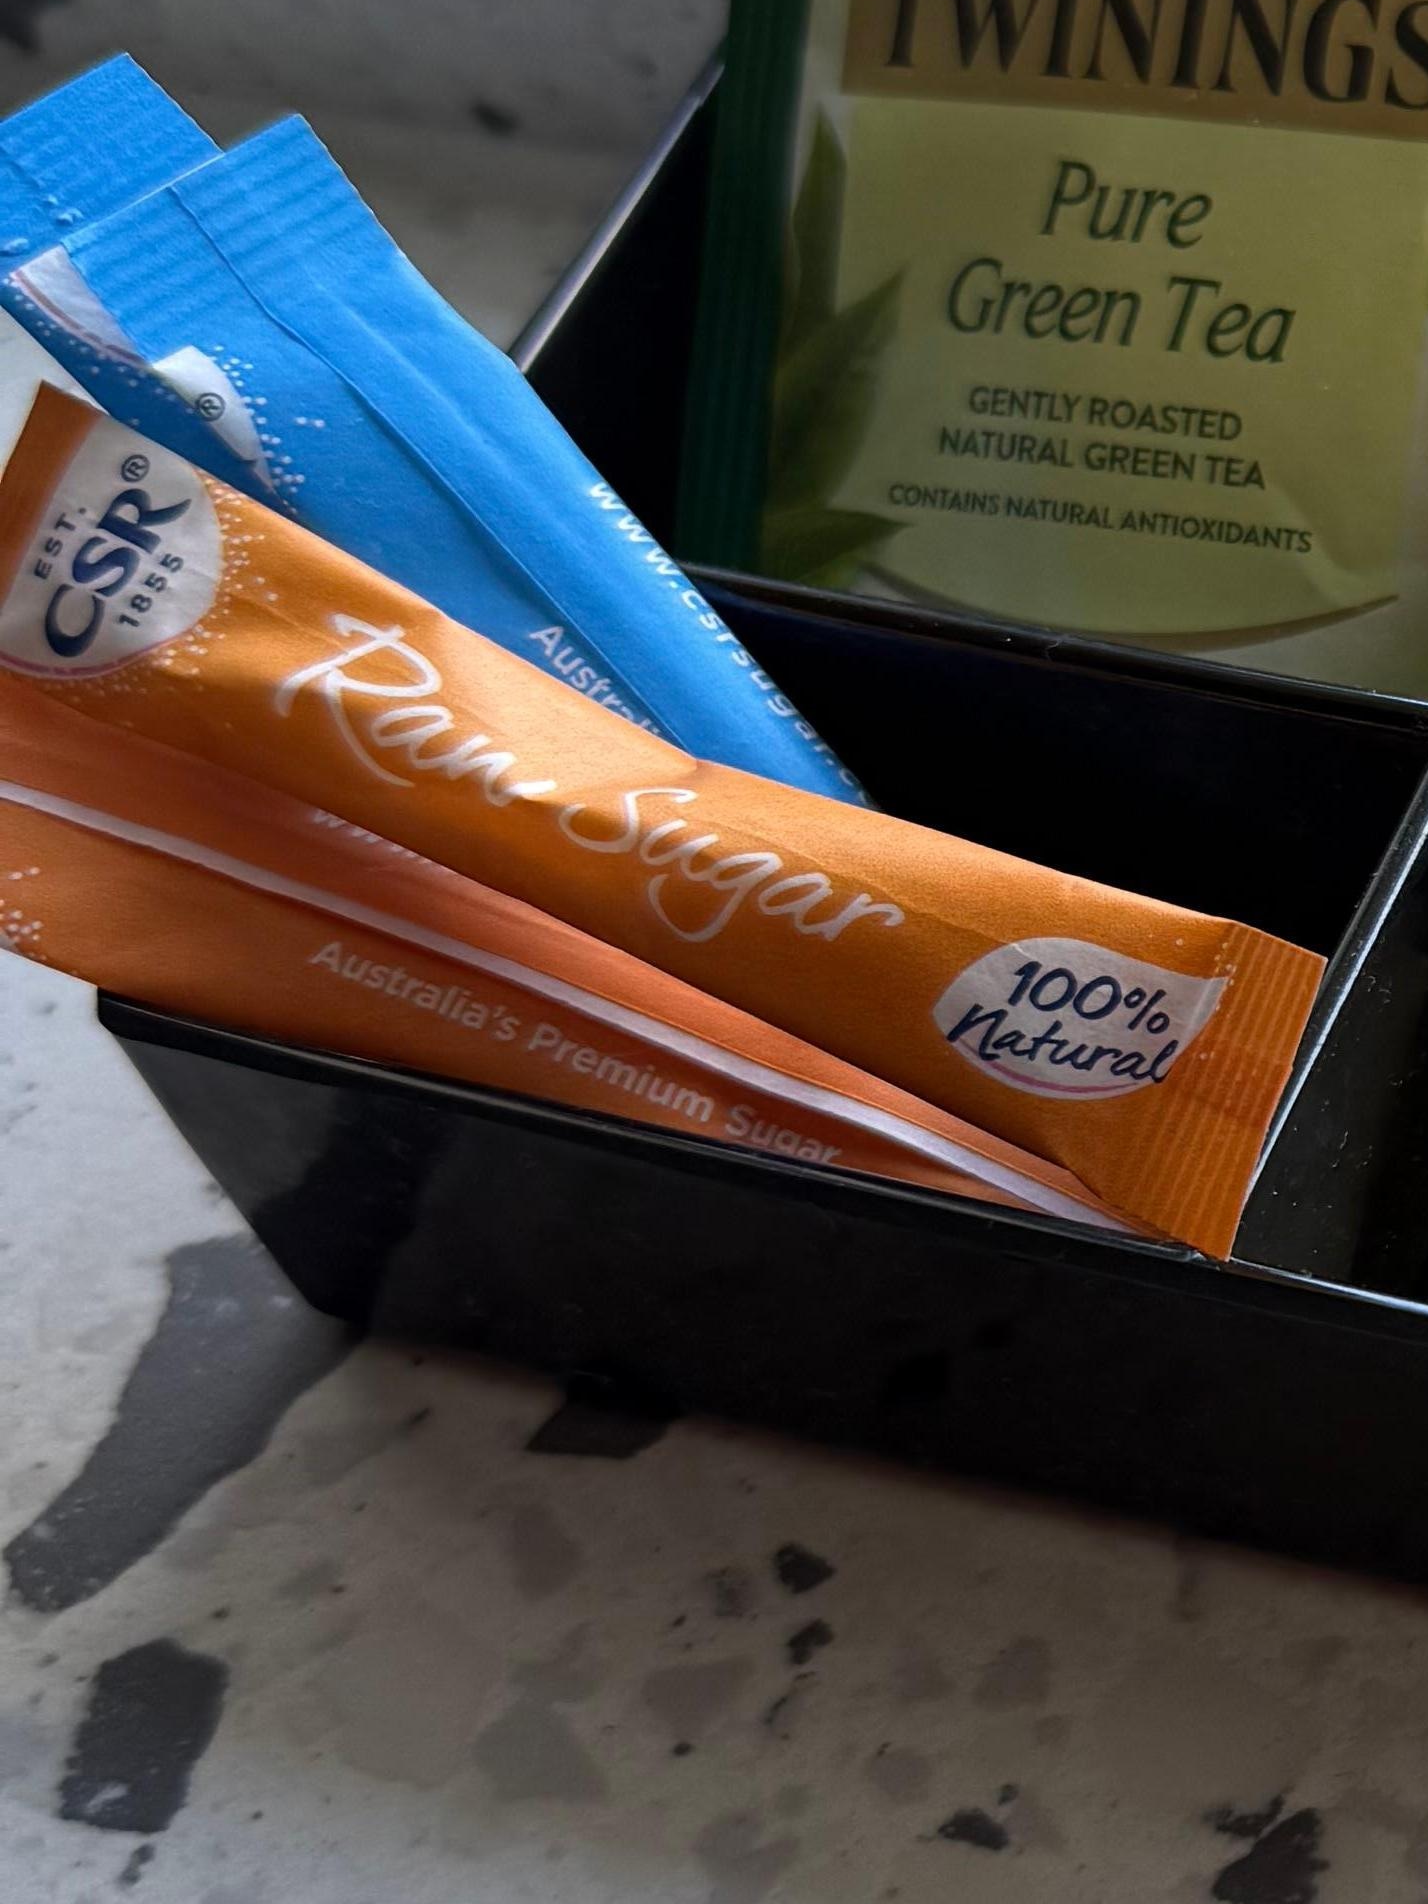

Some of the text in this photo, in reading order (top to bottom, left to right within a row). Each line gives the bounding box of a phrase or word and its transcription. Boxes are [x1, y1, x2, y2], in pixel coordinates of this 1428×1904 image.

[1039, 159, 1213, 249] Pure
[946, 256, 1297, 364] Green Tea
[968, 385, 1243, 442] GENTLY ROASTED
[938, 426, 1266, 490] NATURAL GREEN TEA
[33, 506, 88, 580] EST.
[888, 483, 1313, 553] CONTAINS NATURAL ANTIOXIDANTS
[116, 553, 185, 628] 1855
[274, 612, 558, 807] Raw
[556, 786, 906, 943] Sugar
[1006, 960, 1171, 1035] 100%
[310, 940, 842, 1167] Australia's Premium Sugar
